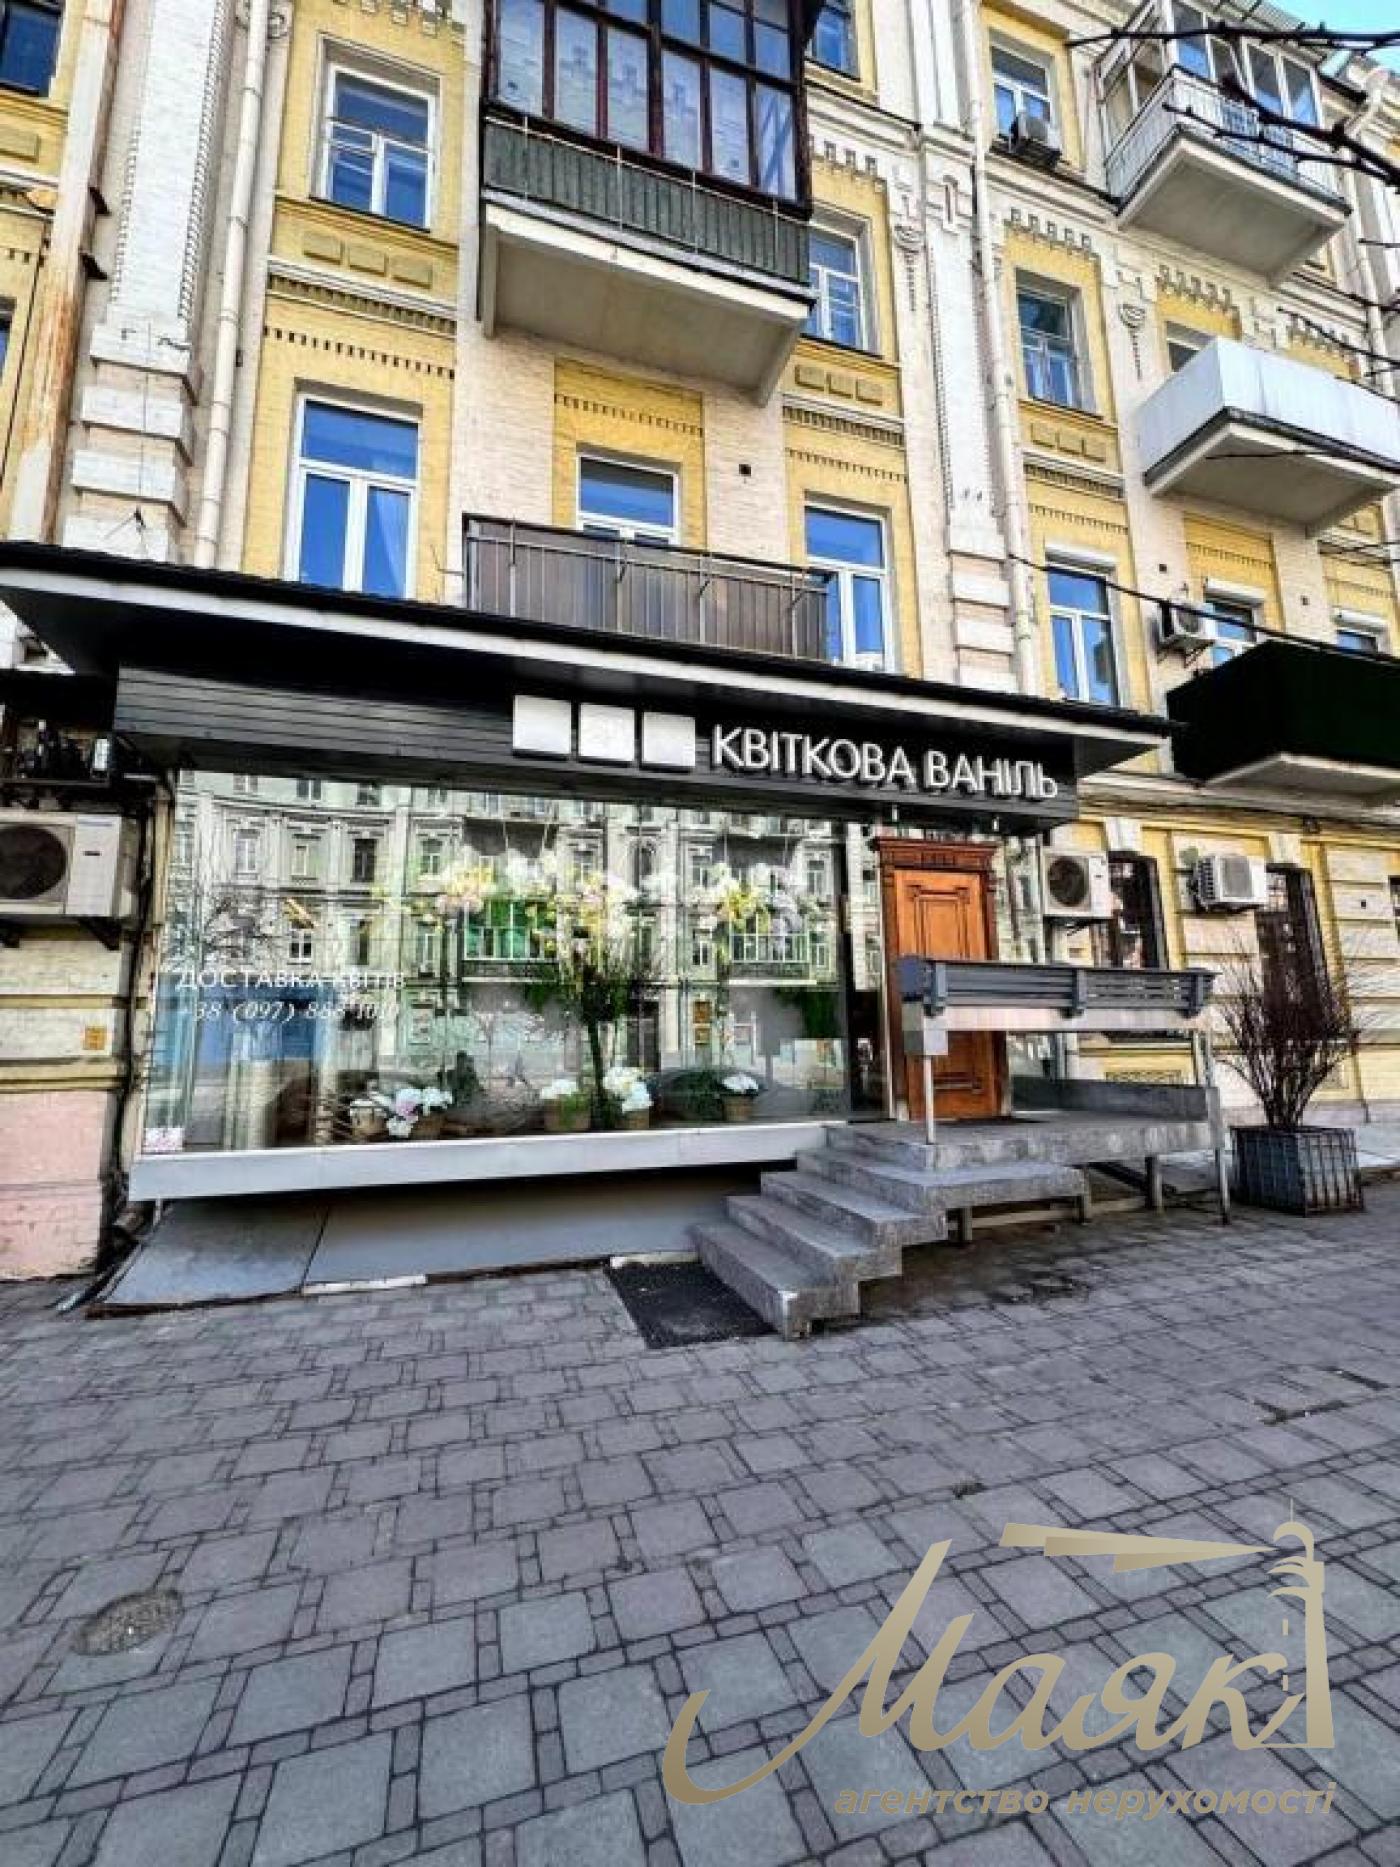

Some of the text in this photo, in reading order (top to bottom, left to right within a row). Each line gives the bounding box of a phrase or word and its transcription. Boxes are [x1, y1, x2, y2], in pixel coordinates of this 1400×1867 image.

[712, 723, 1059, 799] КВІТКОВА ВАНІЛЬ
[174, 966, 320, 991] ДОСТАВКА
